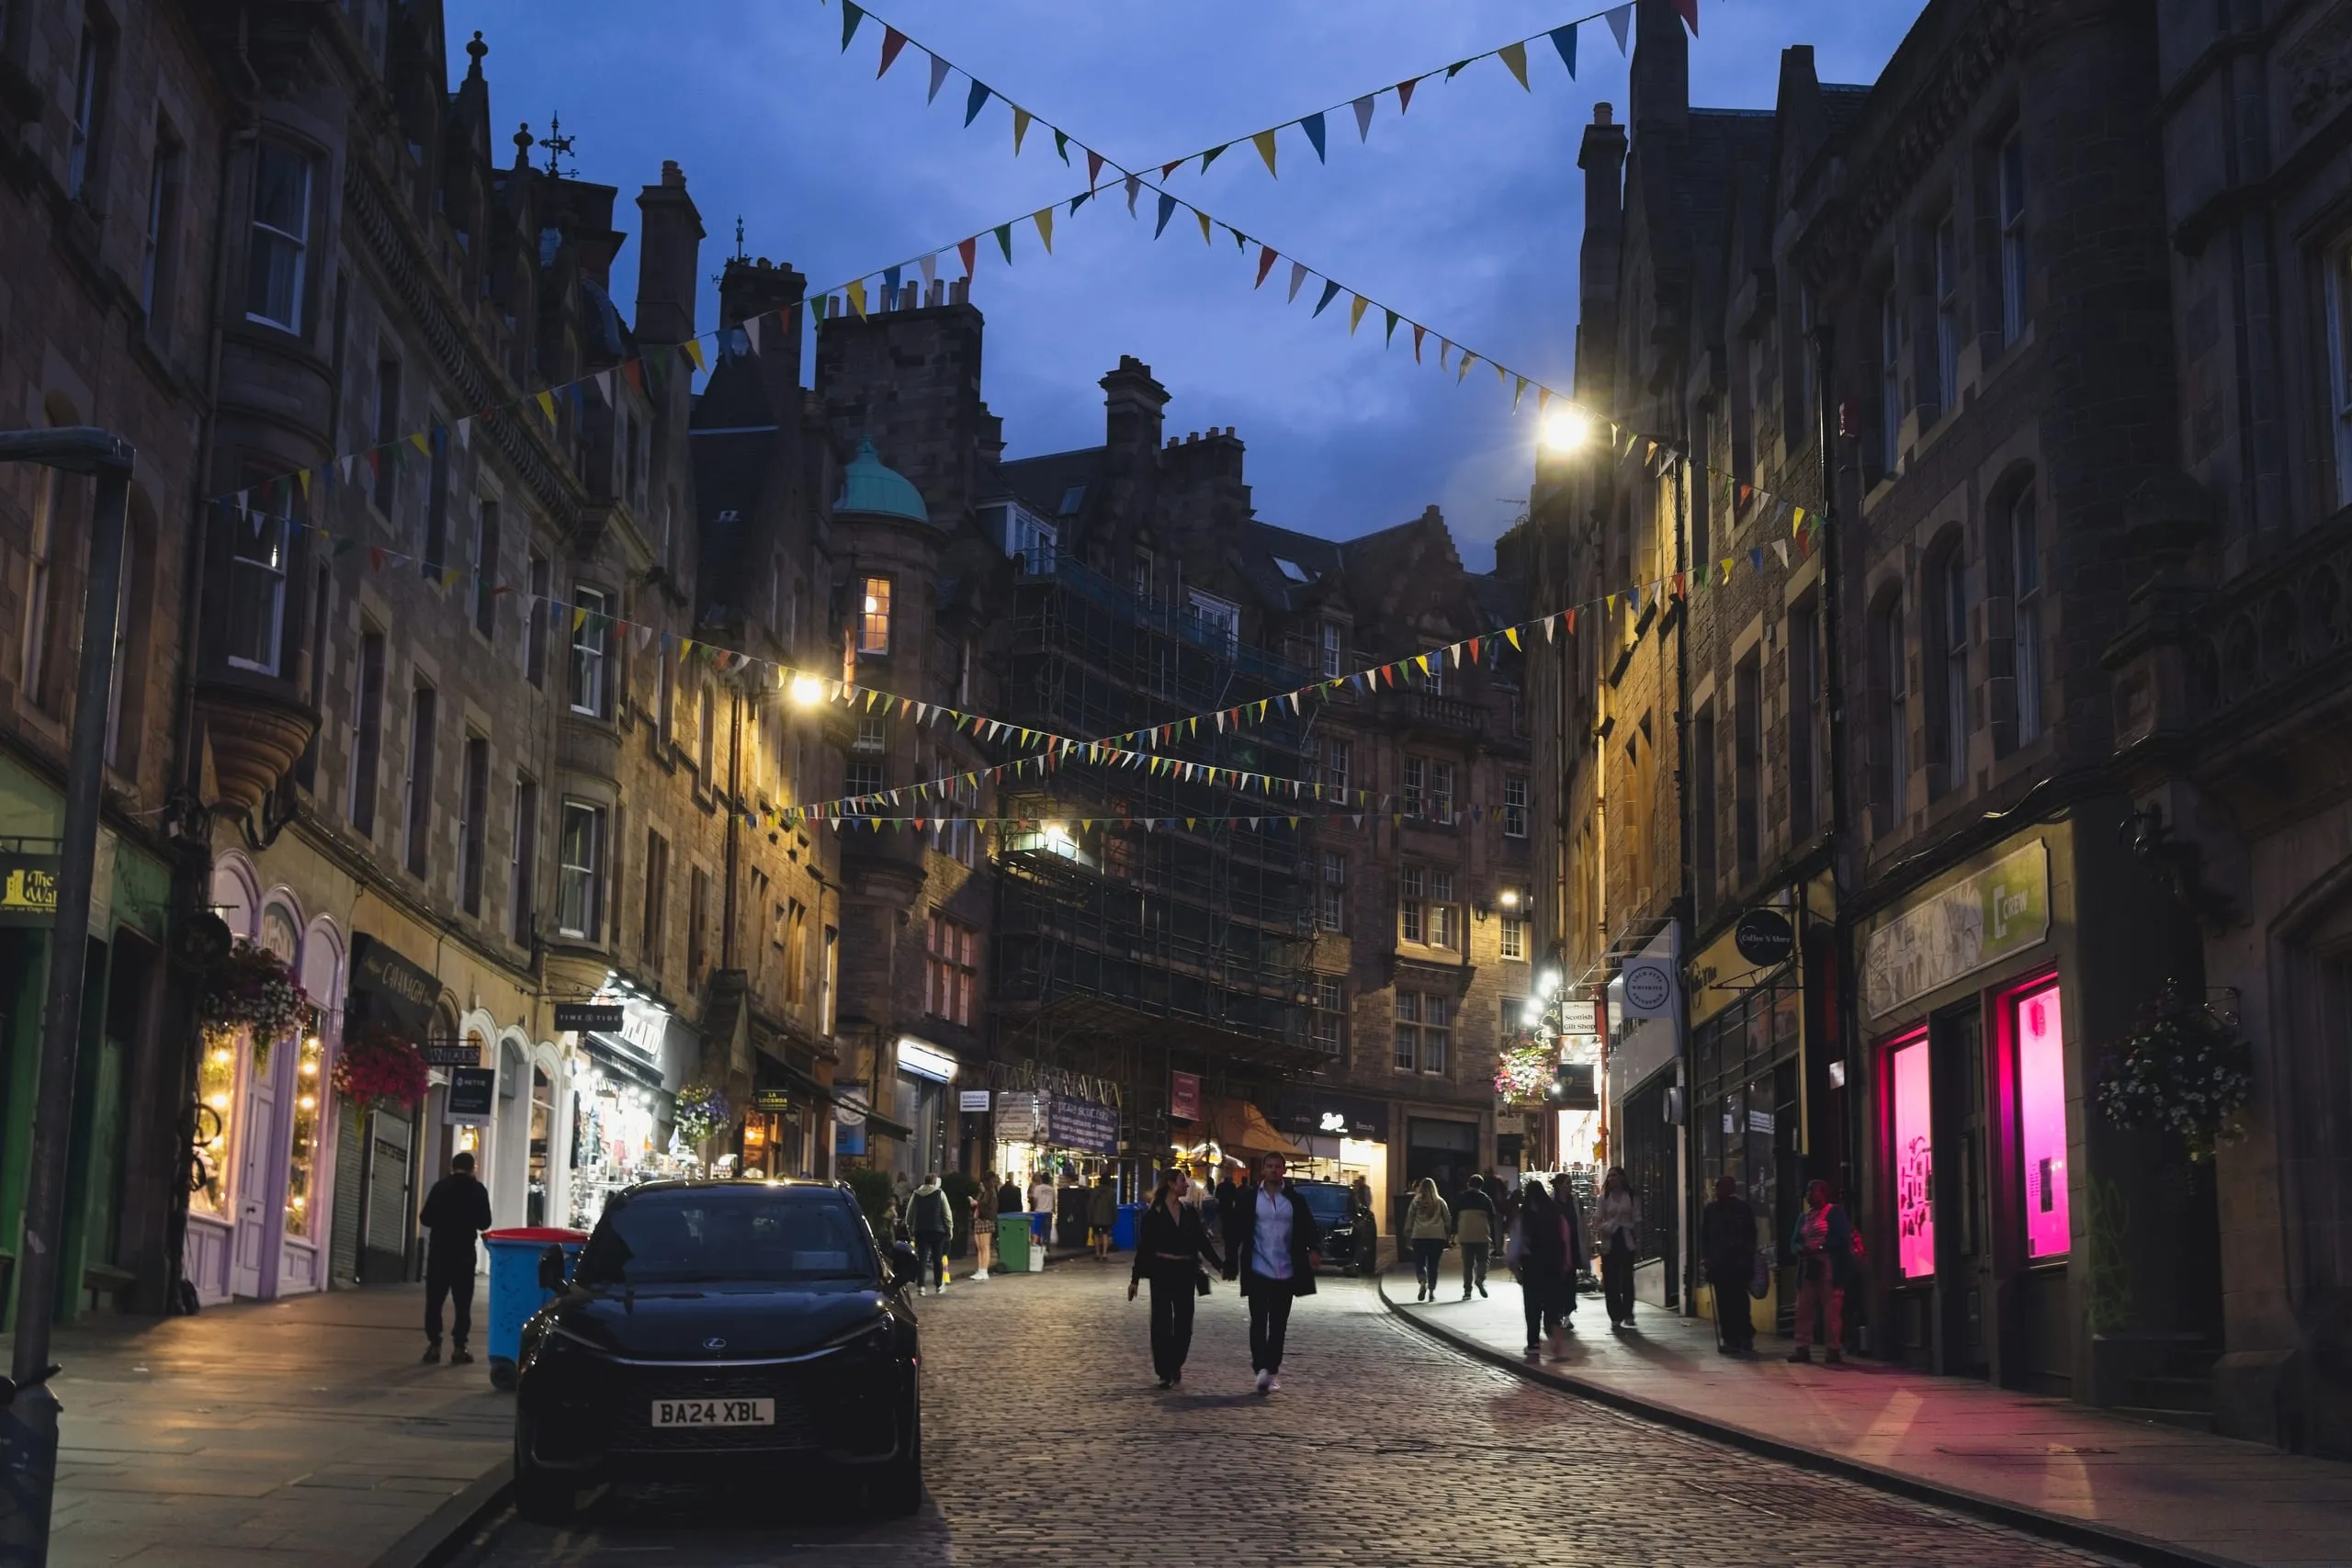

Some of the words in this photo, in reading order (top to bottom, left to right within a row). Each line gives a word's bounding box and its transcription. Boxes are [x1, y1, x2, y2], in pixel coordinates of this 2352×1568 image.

[28, 870, 54, 887] The
[2002, 889, 2029, 919] CREW
[560, 1013, 582, 1021] TIME
[595, 1014, 619, 1022] TIDE
[661, 1403, 717, 1423] BA24
[723, 1402, 765, 1422] XBL
